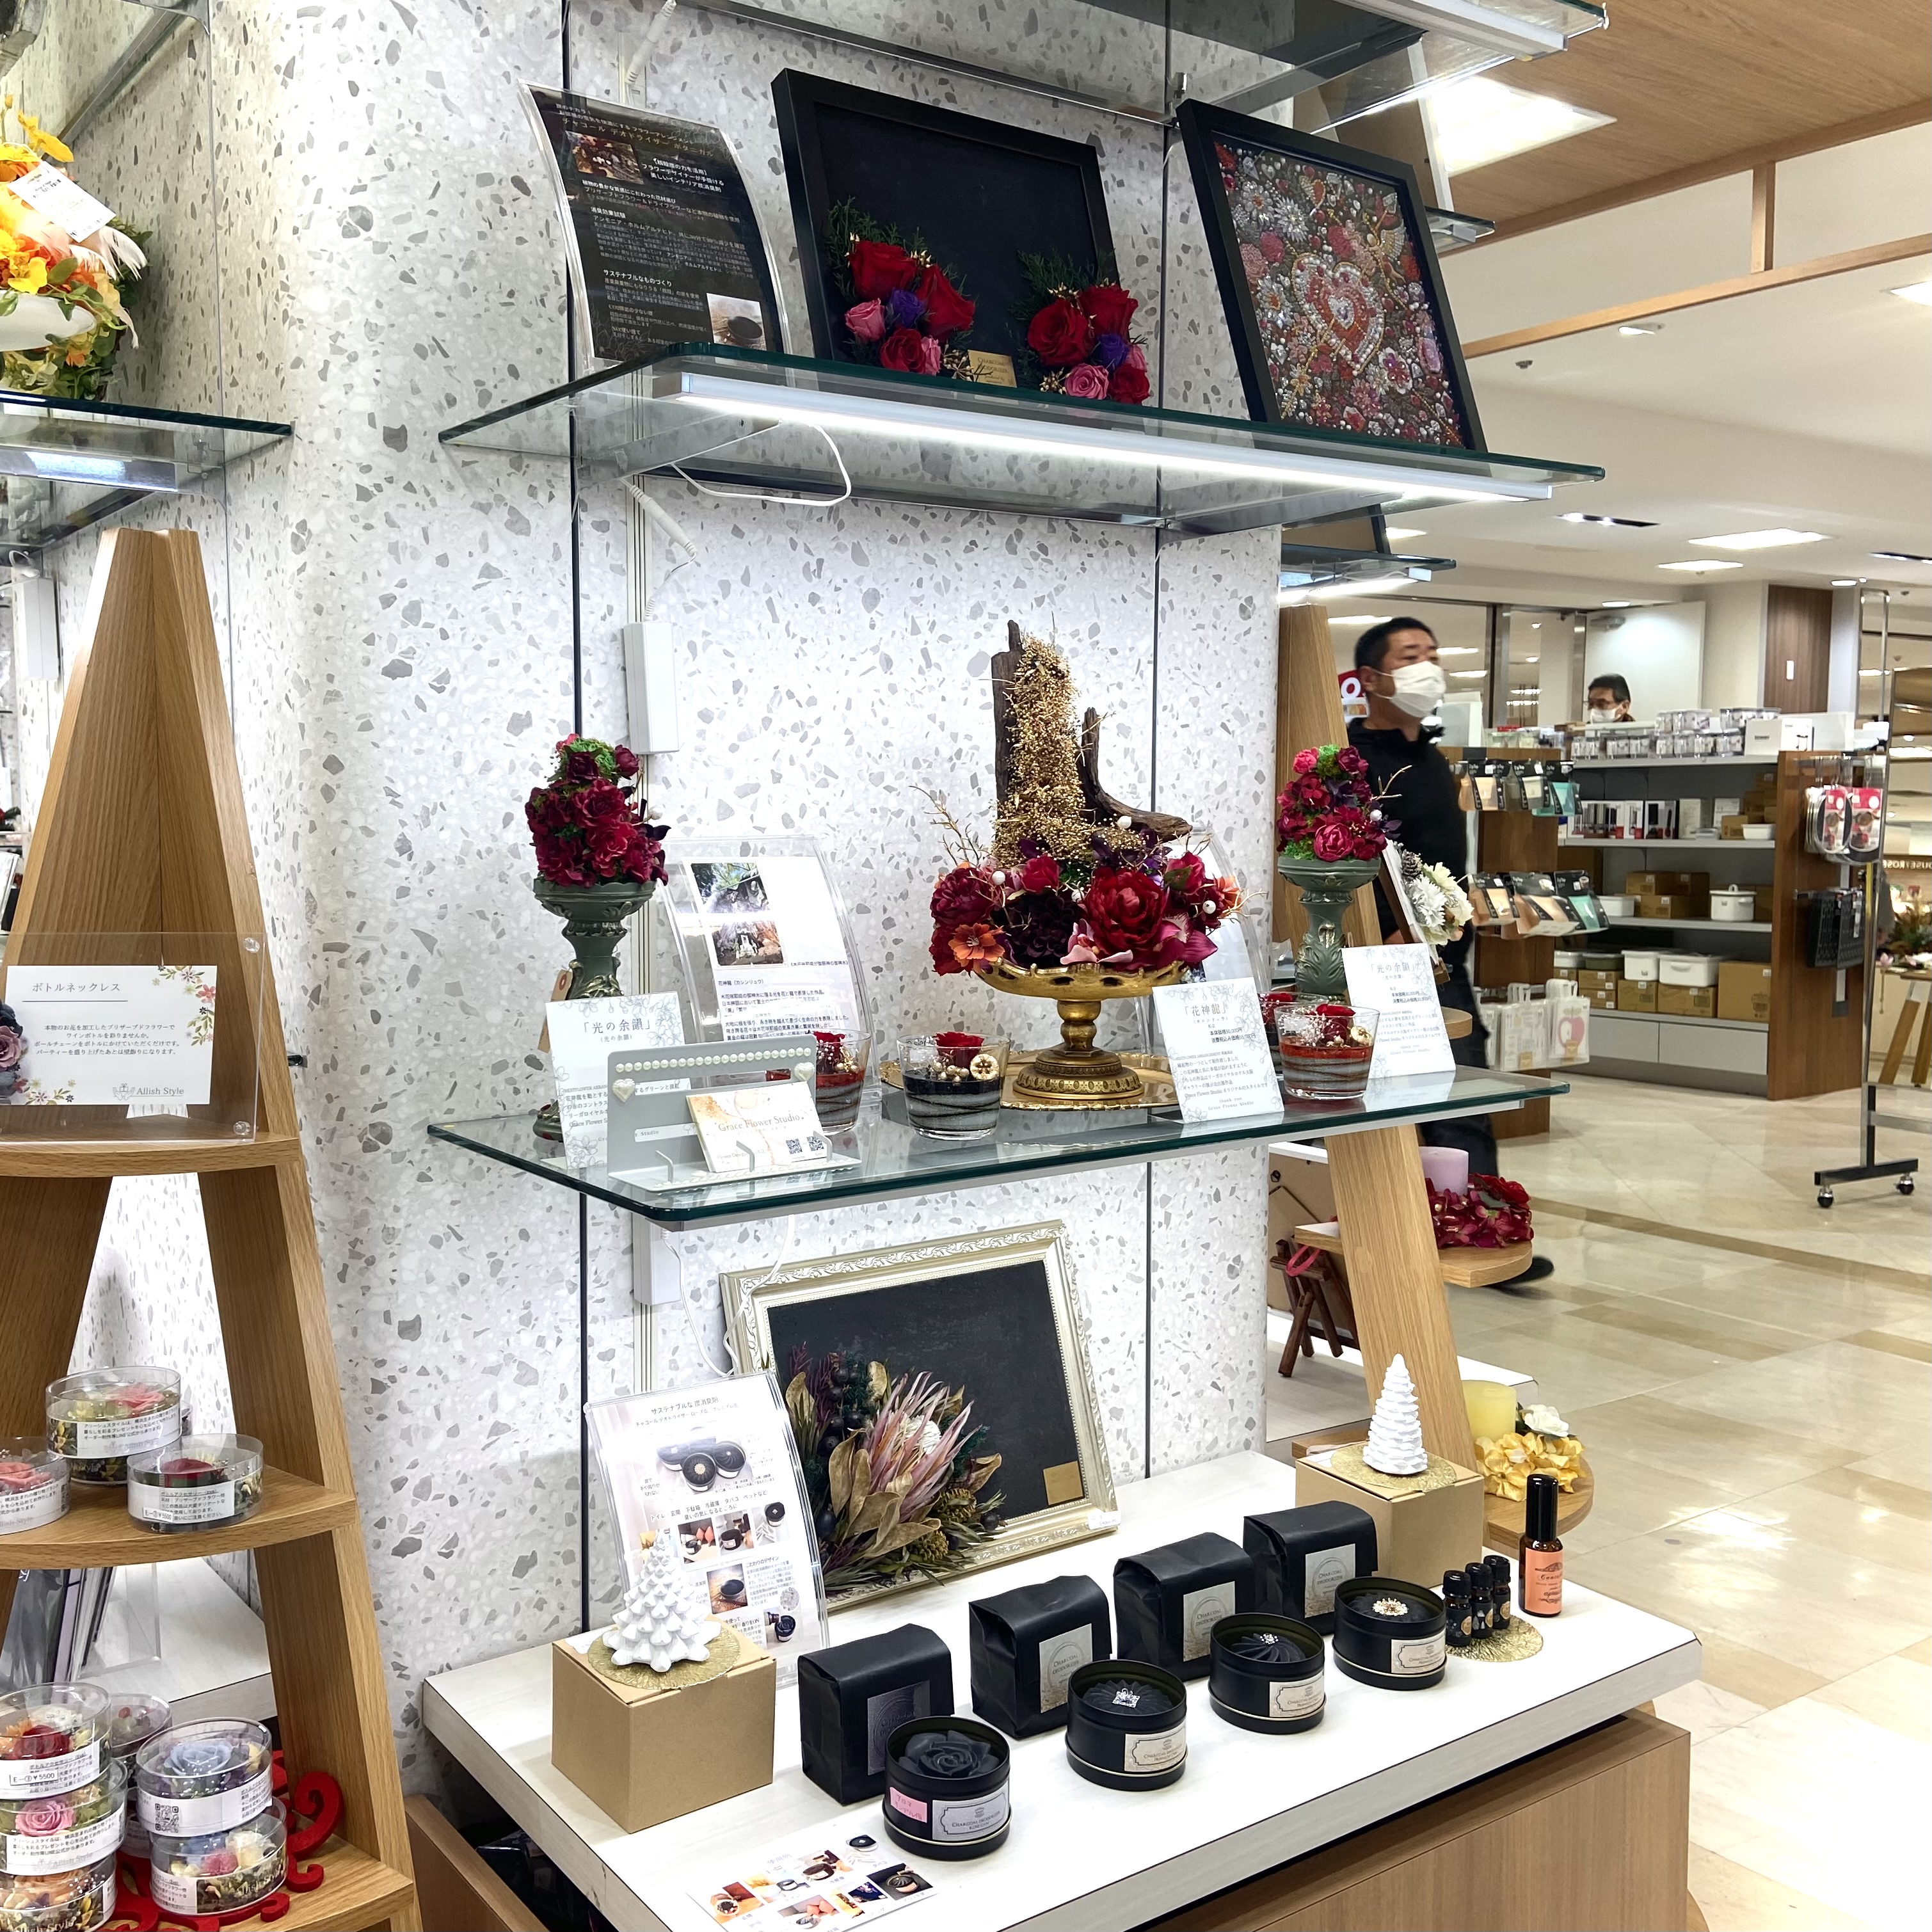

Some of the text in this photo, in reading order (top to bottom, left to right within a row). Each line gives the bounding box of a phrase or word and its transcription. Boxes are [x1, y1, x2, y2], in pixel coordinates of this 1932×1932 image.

[584, 1019, 650, 1034] 「光の余韻」
[163, 1087, 184, 1096] Style
[719, 1114, 800, 1131] Grace Flower Studio
[1197, 1609, 1222, 1619] CHARCOAL
[1053, 1654, 1078, 1667] CHARCOAL
